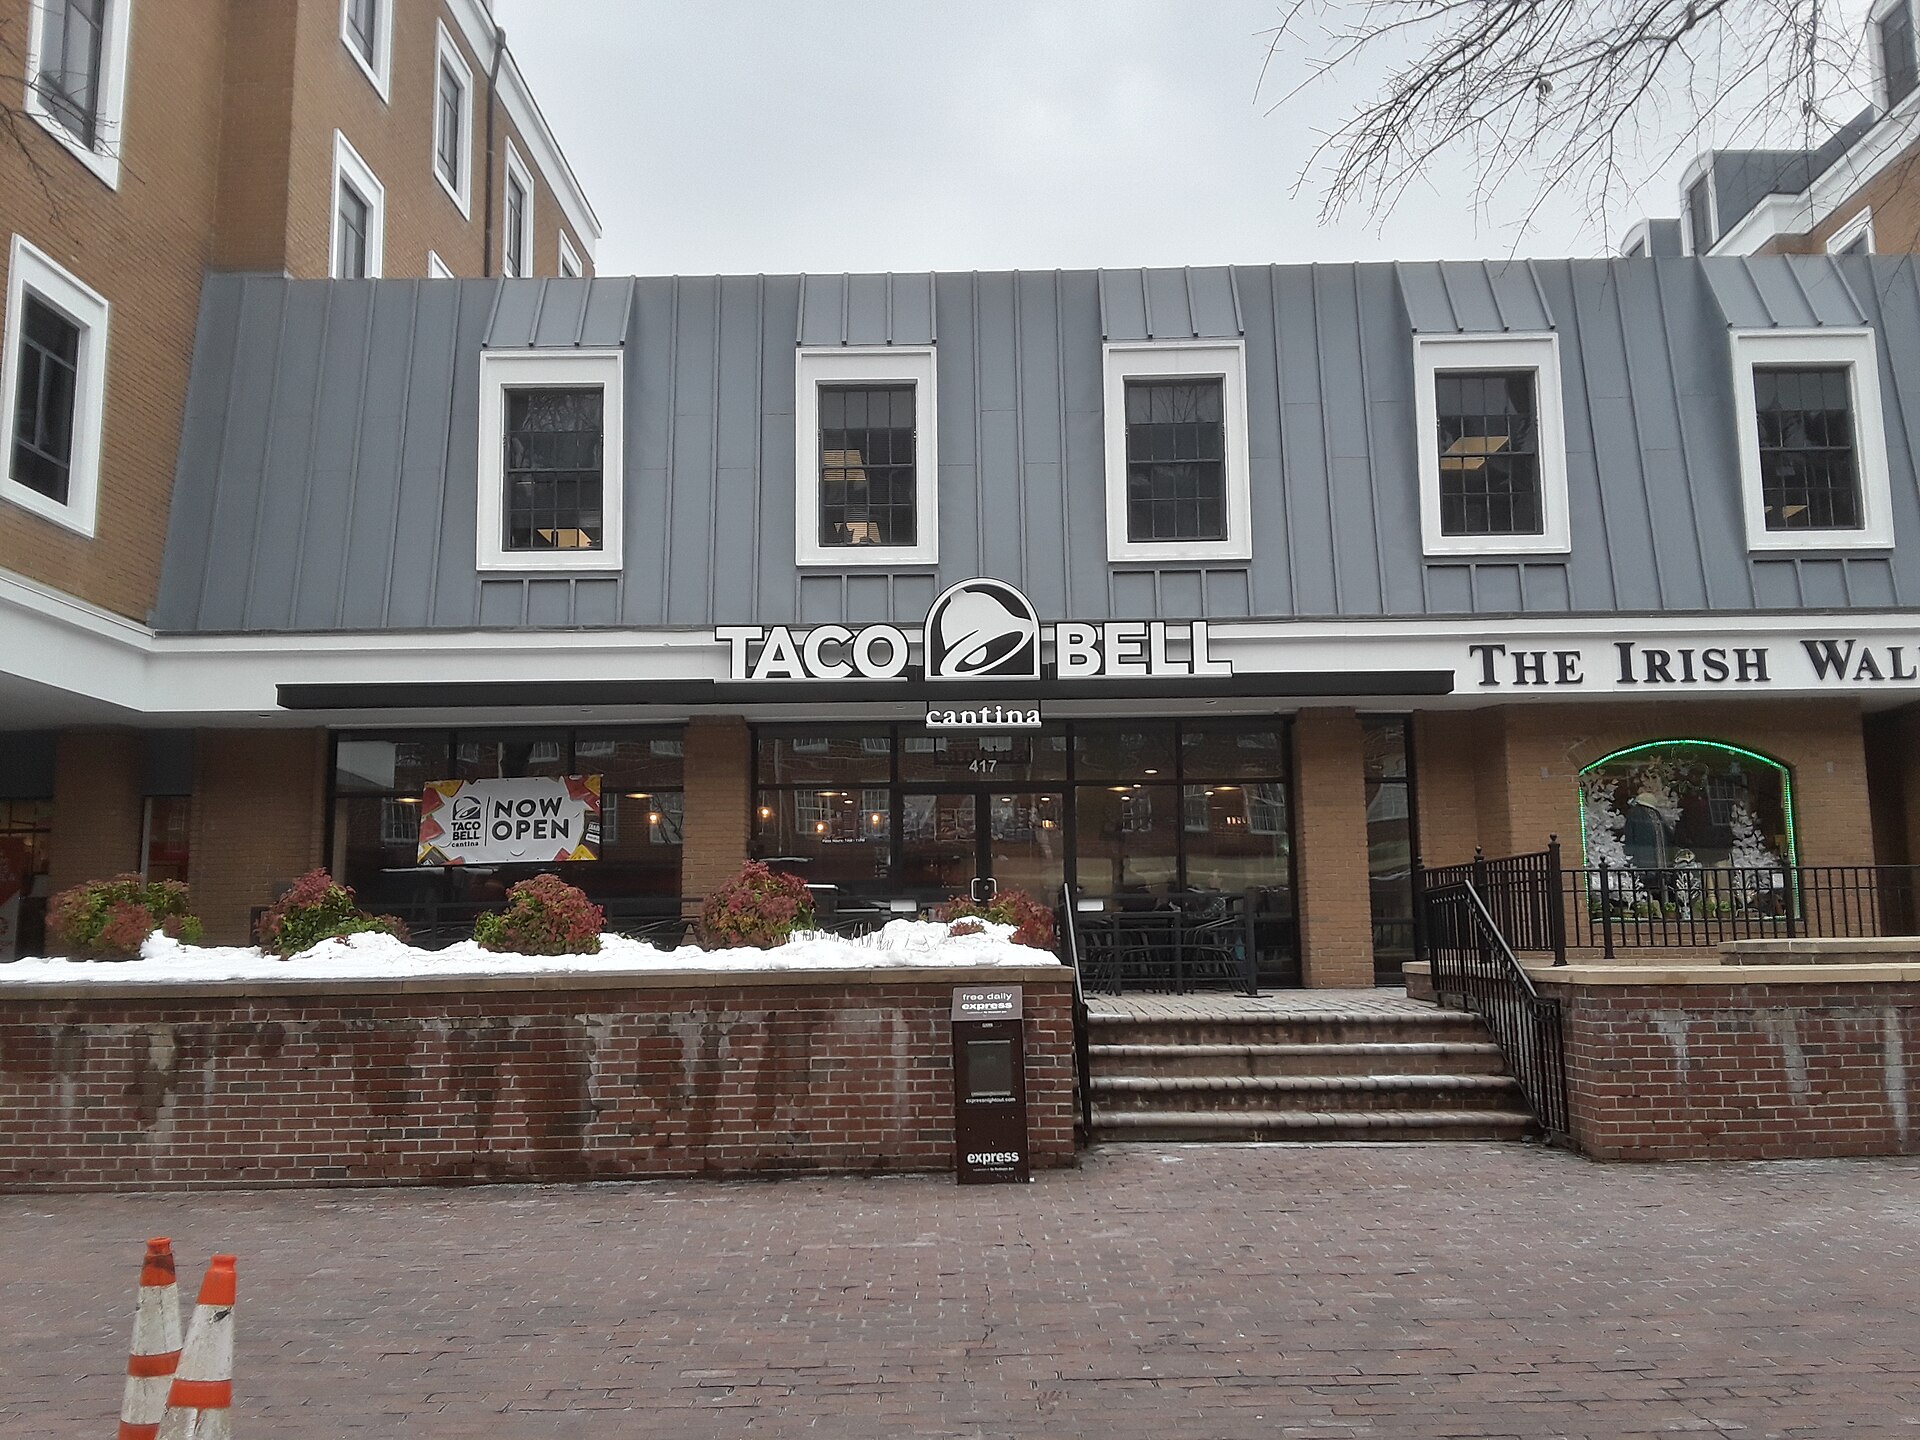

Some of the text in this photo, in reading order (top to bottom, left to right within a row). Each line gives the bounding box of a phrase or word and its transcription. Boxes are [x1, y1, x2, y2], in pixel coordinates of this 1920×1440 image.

[714, 621, 1233, 681] TACO BELL
[1469, 639, 1920, 686] THE IRISH WAL
[926, 705, 1041, 726] cantina
[968, 759, 998, 774] 417
[493, 796, 563, 819] NOW
[451, 821, 481, 832] TACO
[491, 818, 569, 841] OPEN
[452, 830, 480, 841] BELL
[451, 840, 479, 848] cantina
[962, 992, 1013, 1001] free daily
[961, 1002, 1013, 1011] express
[966, 1151, 1020, 1166] express
